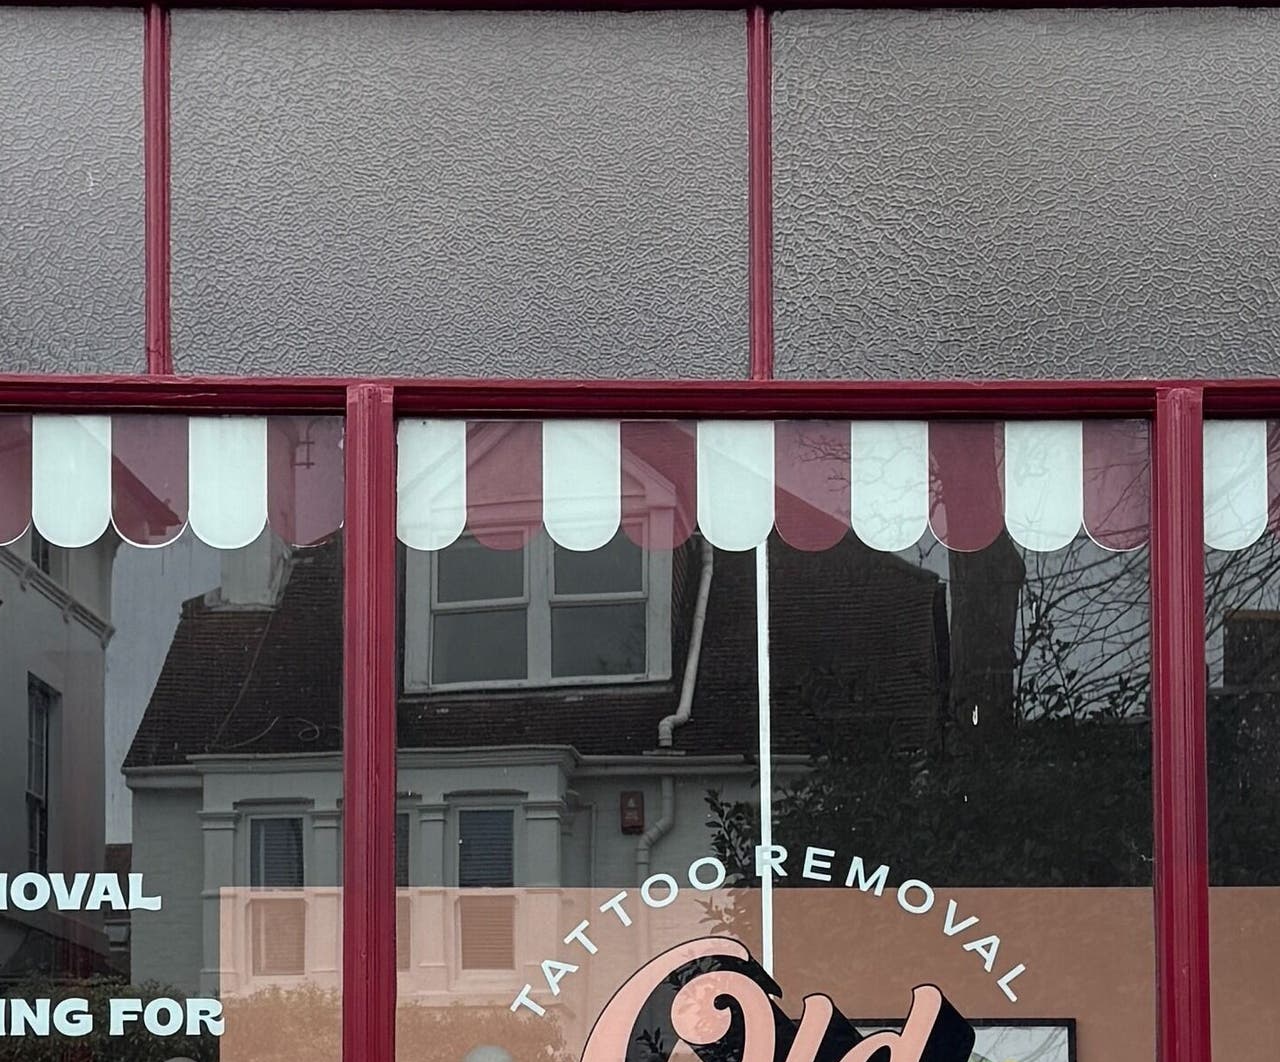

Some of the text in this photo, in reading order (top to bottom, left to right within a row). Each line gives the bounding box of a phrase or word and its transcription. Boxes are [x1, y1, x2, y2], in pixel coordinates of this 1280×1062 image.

[510, 844, 1026, 1017] TATTOO REMOVAL
[109, 997, 226, 1036] FOR
